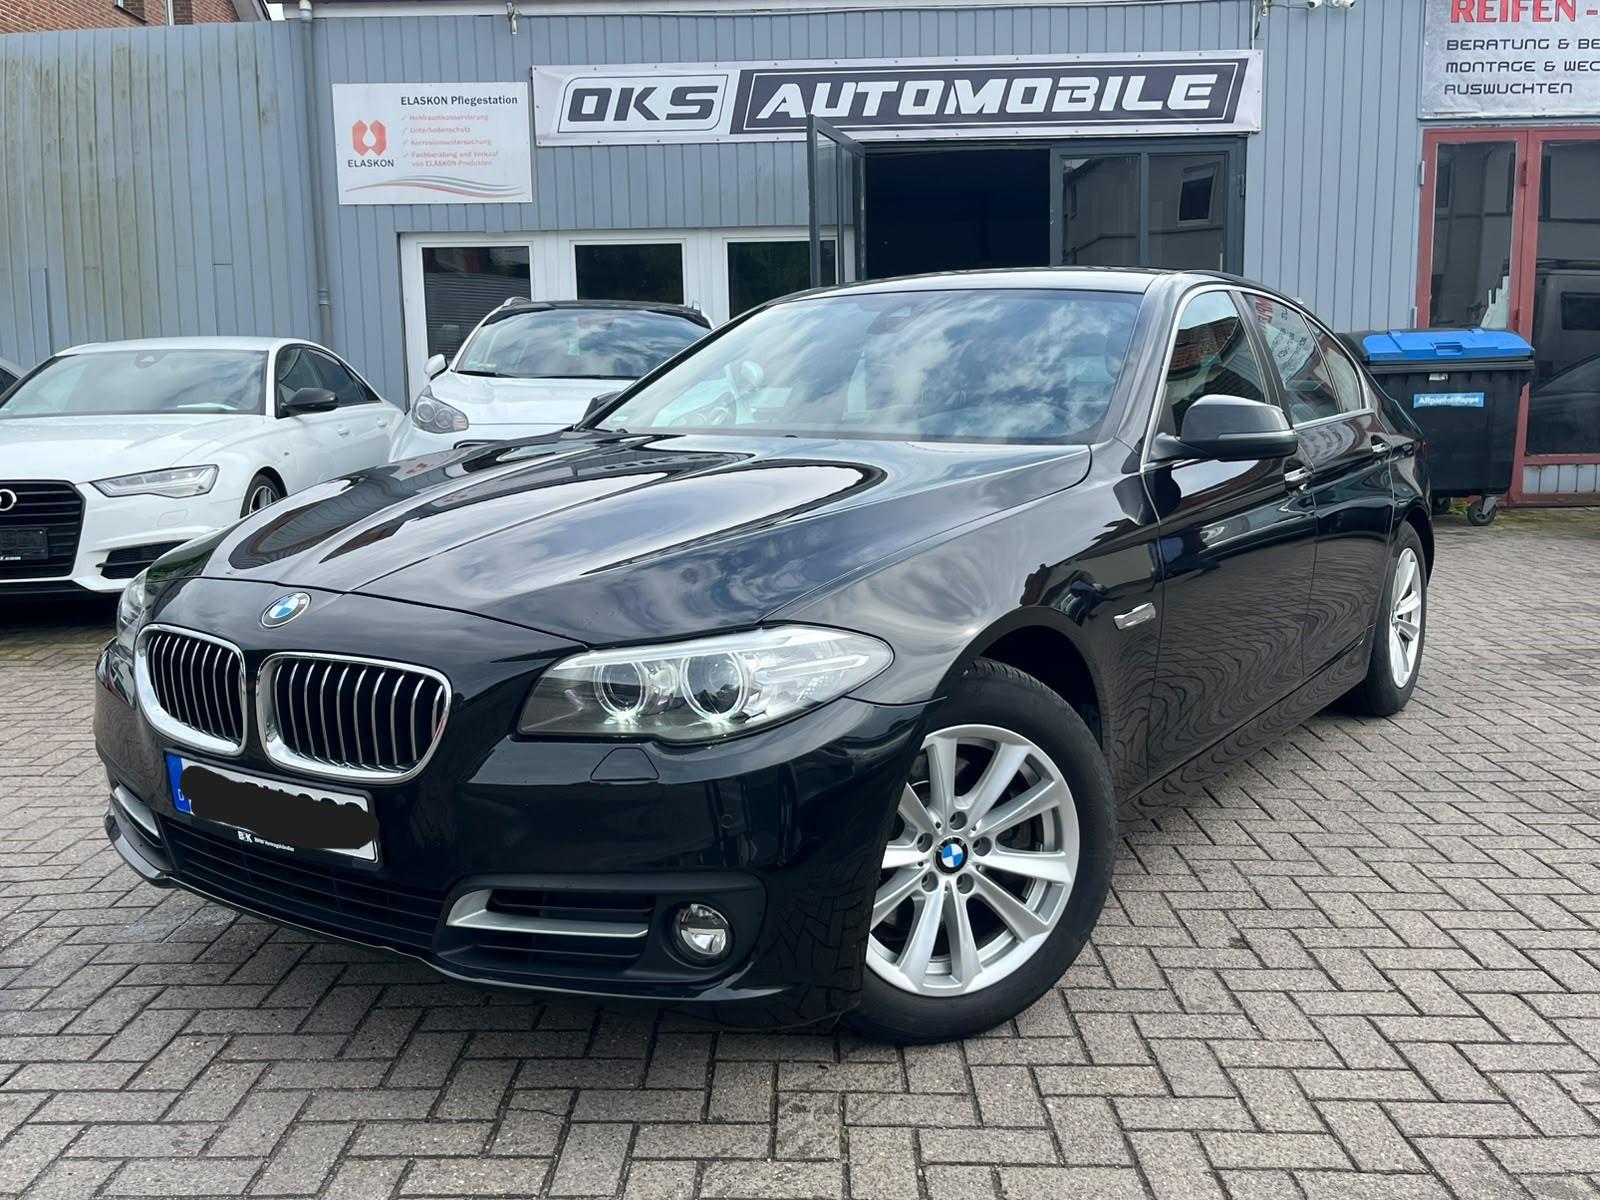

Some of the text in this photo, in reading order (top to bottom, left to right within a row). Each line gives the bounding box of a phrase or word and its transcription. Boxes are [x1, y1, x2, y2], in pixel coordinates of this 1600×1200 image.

[1450, 0, 1577, 23] REIFEN
[1446, 38, 1550, 51] BERATUNG
[1557, 38, 1570, 50] &
[1445, 60, 1536, 73] MONTAGE
[1543, 60, 1556, 72] &
[1443, 82, 1573, 95] AUSWUCHTEN
[400, 95, 518, 107] ELASKON Pflegestation
[567, 73, 1219, 122] OKS AUTOMOBILE
[347, 159, 395, 168] ELASKON
